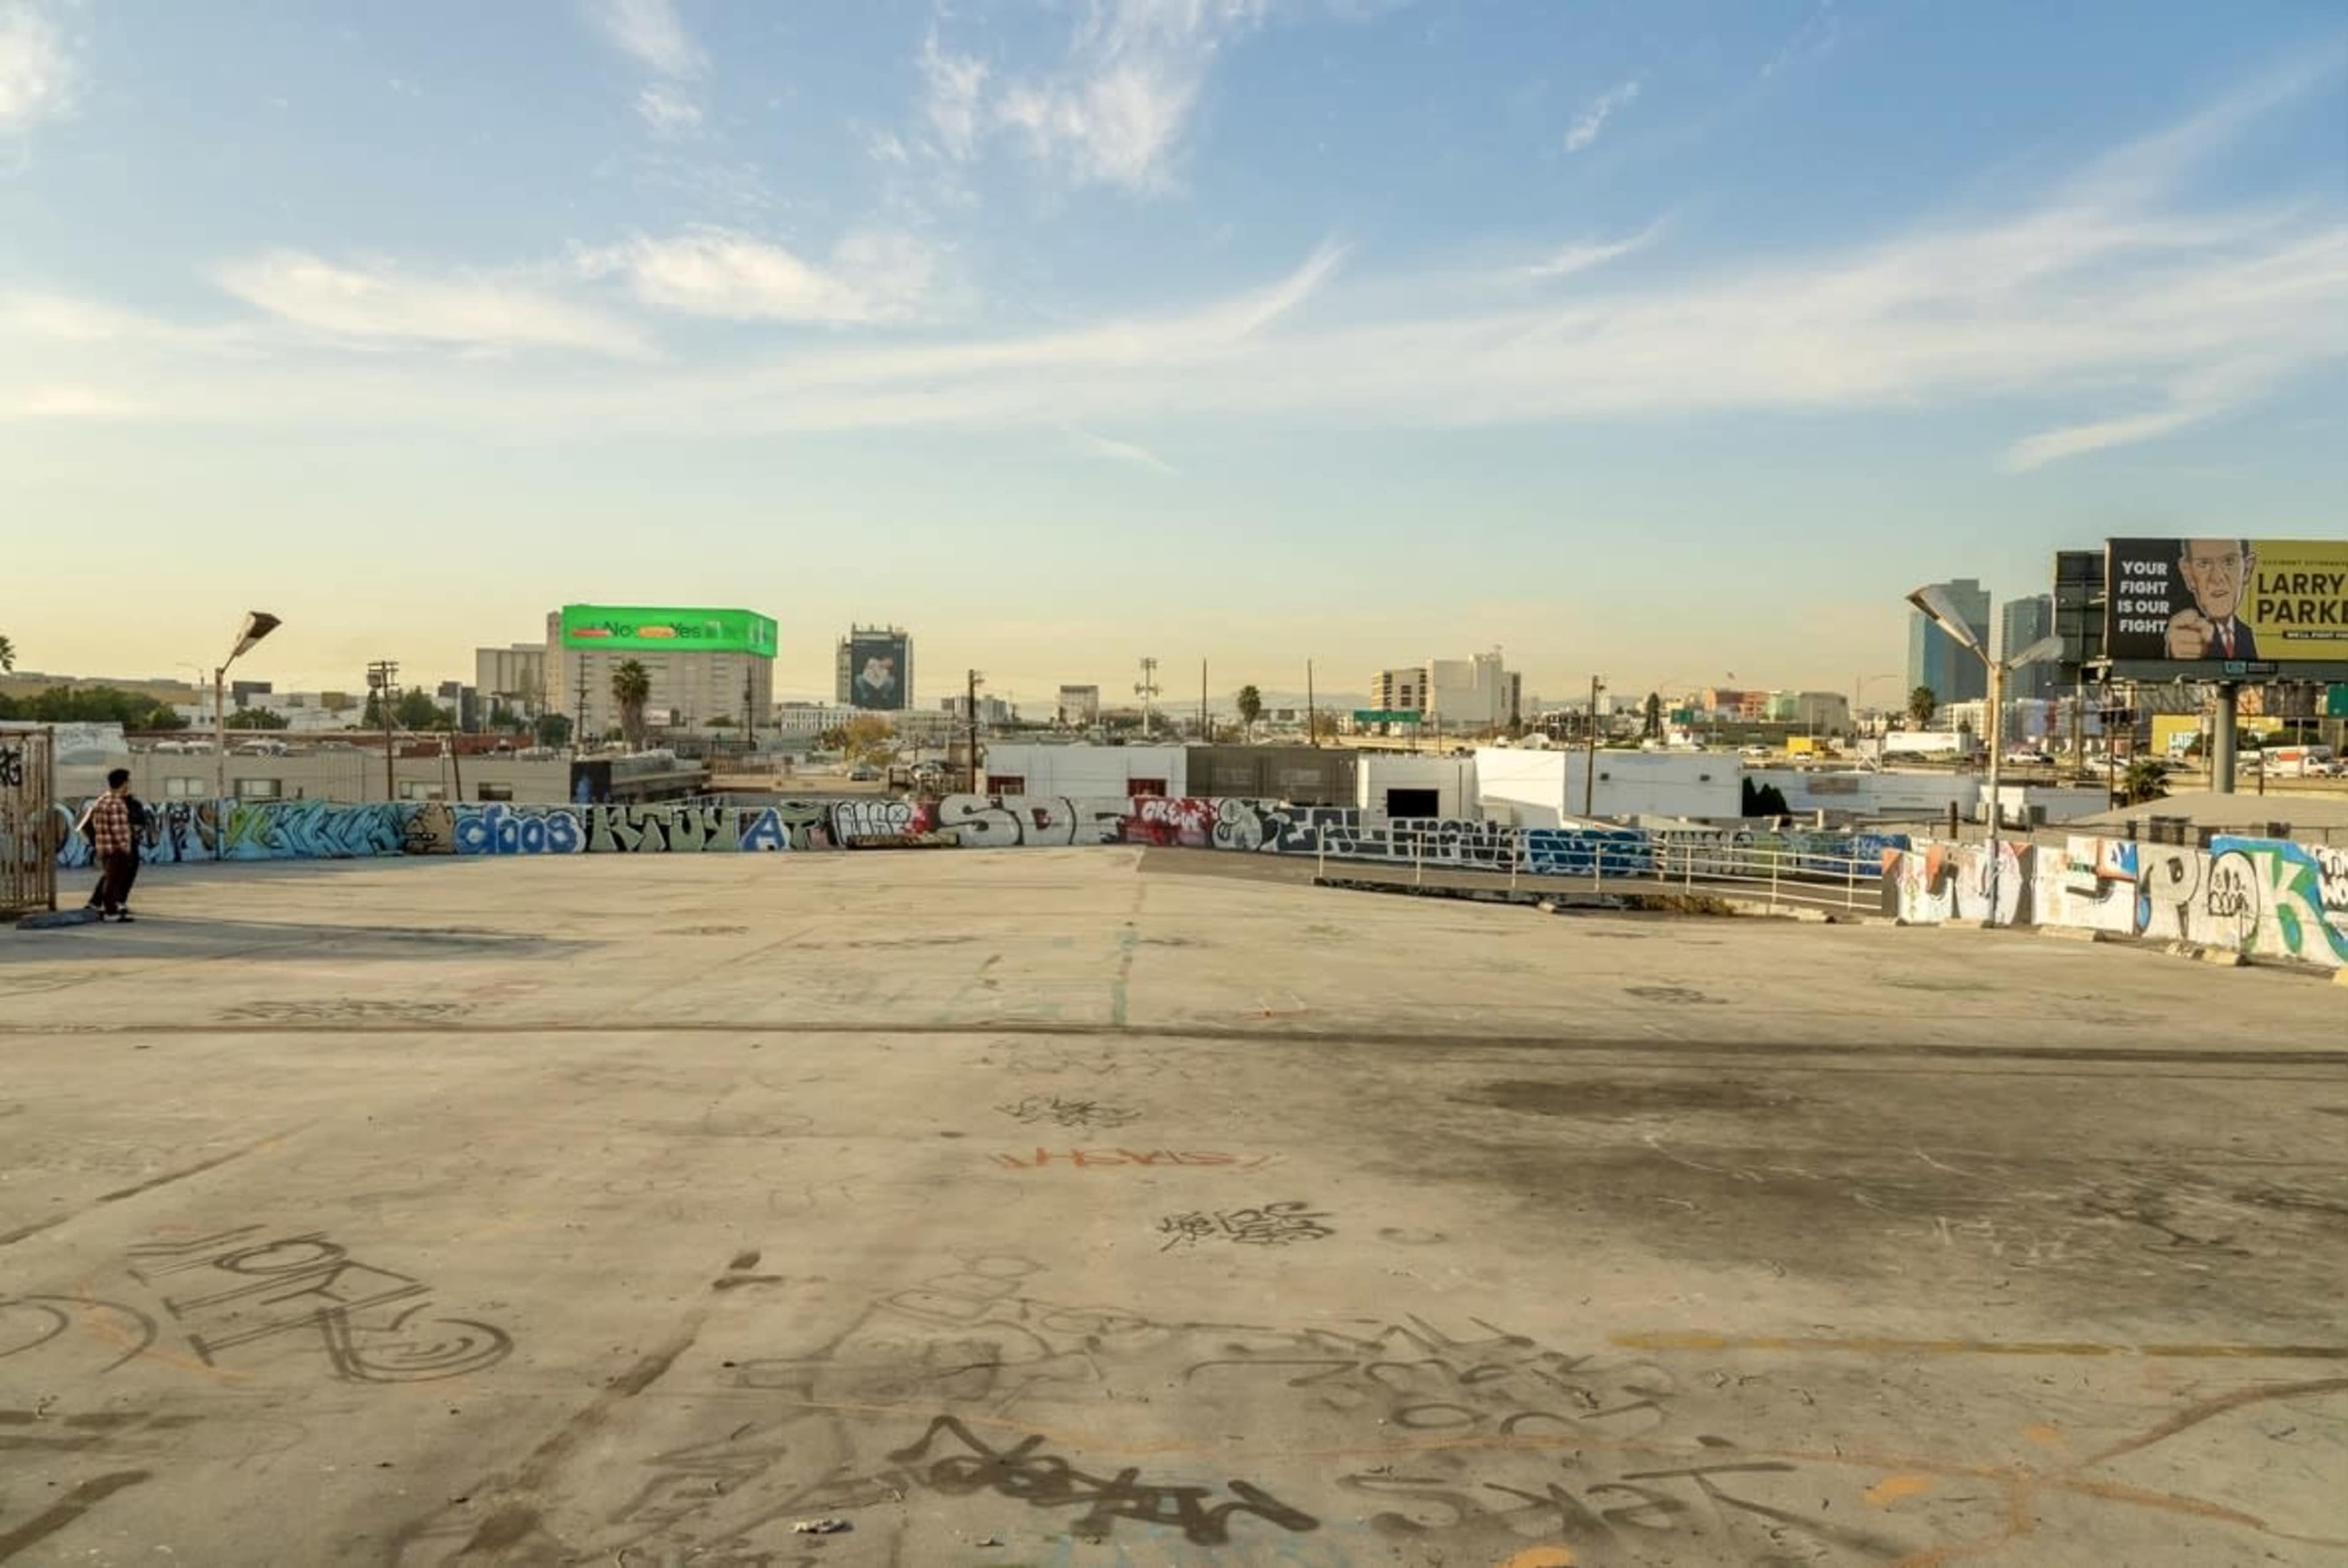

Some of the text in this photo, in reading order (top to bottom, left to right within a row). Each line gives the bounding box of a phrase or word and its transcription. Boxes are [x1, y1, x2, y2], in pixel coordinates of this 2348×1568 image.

[2122, 561, 2168, 575] YOUR
[2120, 581, 2169, 594] FIGHT
[2258, 573, 2346, 595] LARRY
[2117, 600, 2169, 614] IS OUR
[670, 622, 701, 638] Yes
[2119, 619, 2168, 633] FIGHT
